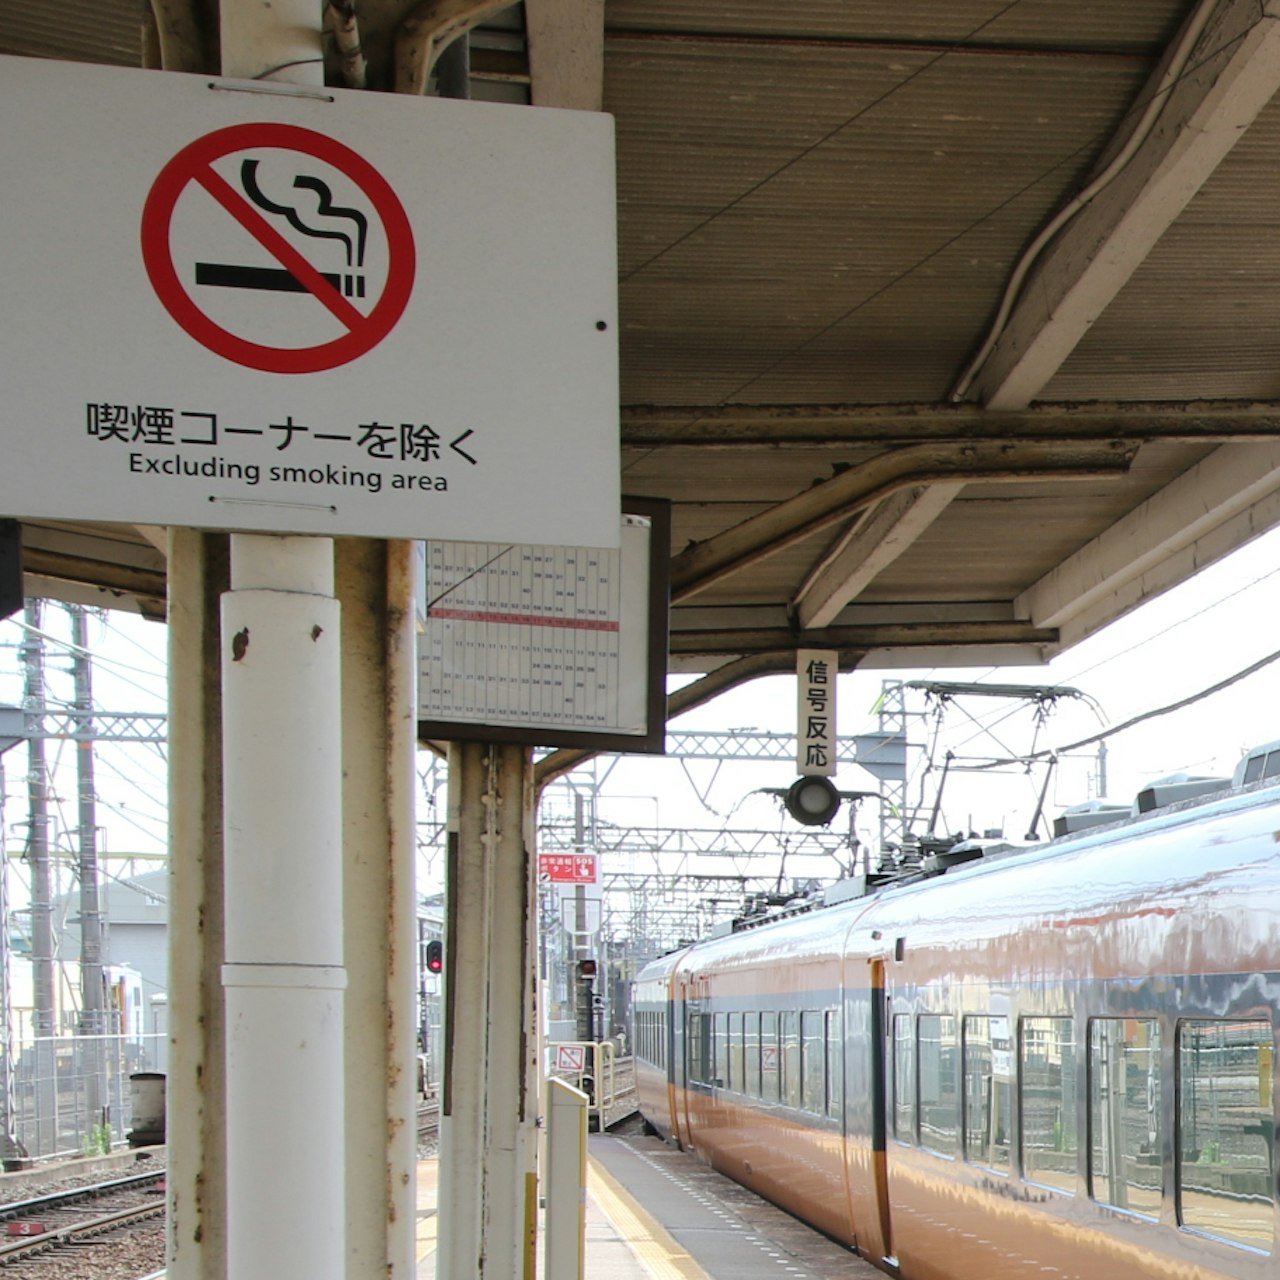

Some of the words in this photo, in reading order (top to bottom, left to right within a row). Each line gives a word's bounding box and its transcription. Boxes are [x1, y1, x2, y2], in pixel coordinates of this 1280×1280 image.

[86, 403, 478, 465] 喫煙コーナーを除く
[129, 453, 260, 485] Excluding
[270, 463, 382, 492] smoking
[391, 473, 448, 491] area
[805, 660, 828, 767] 信号反応
[576, 857, 593, 865] SOS
